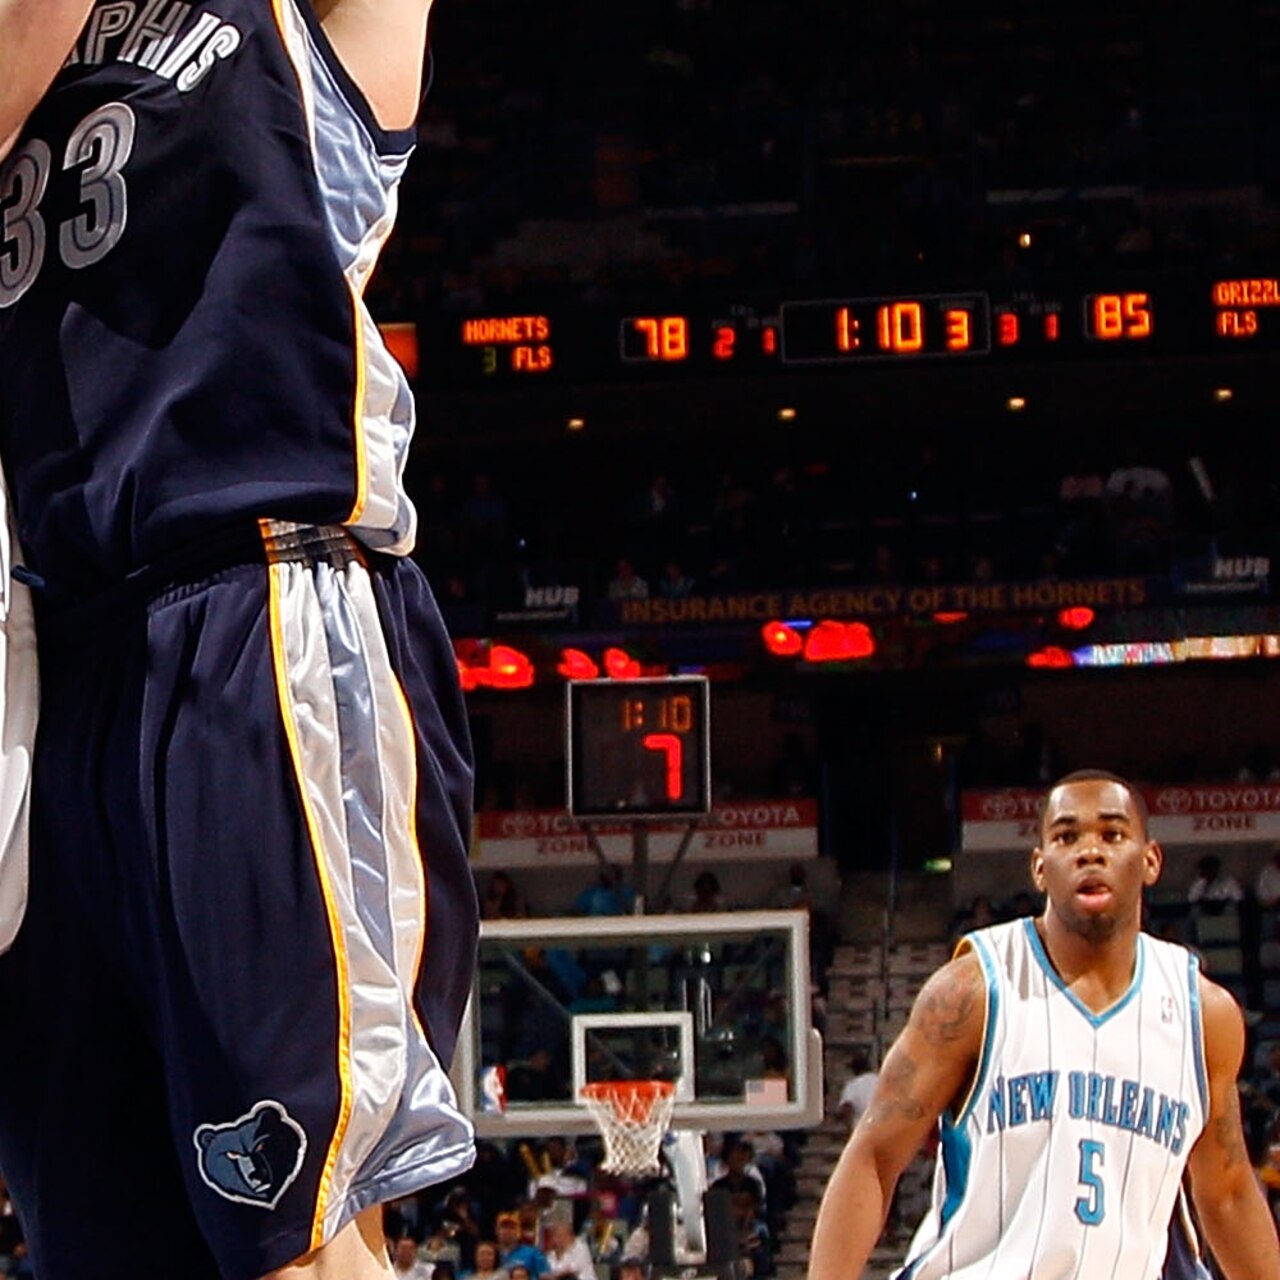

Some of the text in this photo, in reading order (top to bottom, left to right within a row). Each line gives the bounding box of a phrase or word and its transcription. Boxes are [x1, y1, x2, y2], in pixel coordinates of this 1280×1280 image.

[463, 316, 549, 344] HORNETS
[634, 317, 688, 361] 78
[837, 302, 922, 352] 1:10
[946, 309, 970, 351] 3
[1094, 293, 1152, 340] 85
[1217, 310, 1258, 337] FLS
[512, 345, 552, 371] FLS
[622, 579, 1145, 622] INSURANCE AGENCY OF THE HORNETS
[624, 694, 693, 732] 1:10
[642, 733, 683, 801] 7
[987, 1070, 1190, 1157] NEW ORLEANS
[1074, 1138, 1105, 1227] 5
